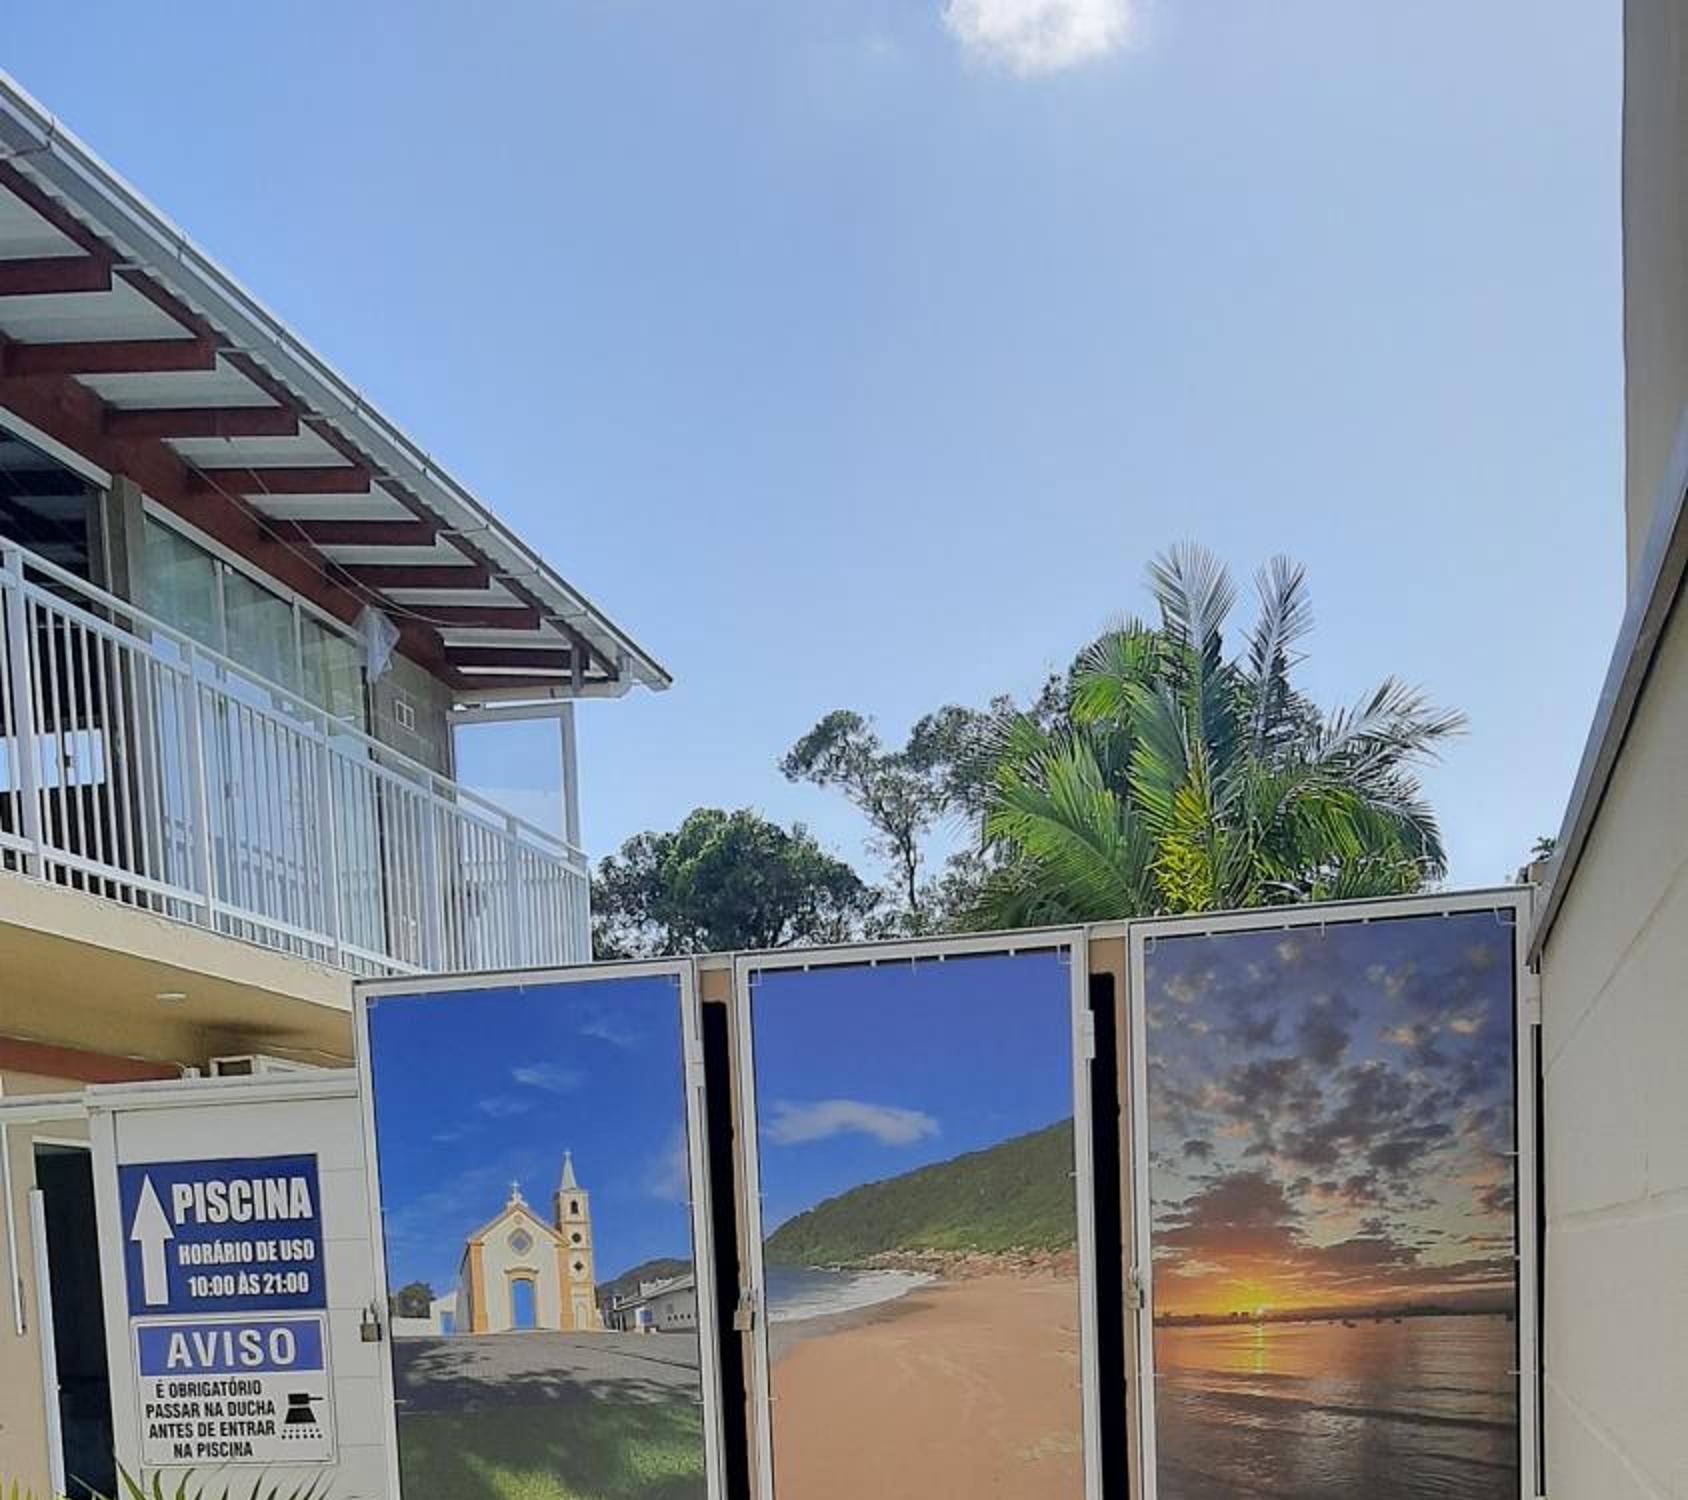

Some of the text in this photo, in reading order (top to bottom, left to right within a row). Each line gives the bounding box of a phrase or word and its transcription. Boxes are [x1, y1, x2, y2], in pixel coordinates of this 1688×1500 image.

[171, 1177, 313, 1225] PISCINA
[178, 1238, 315, 1265] HORÁRIO DE USO
[187, 1270, 309, 1297] 10:00 ÀS 21:00
[167, 1327, 296, 1369] AVISO
[155, 1376, 262, 1399] É OBRIGATÓRIO
[145, 1400, 276, 1419] PASSAR NA DUCHA
[148, 1420, 276, 1439] ANTES DE ENTRAR
[173, 1441, 253, 1458] NA PISCINA
